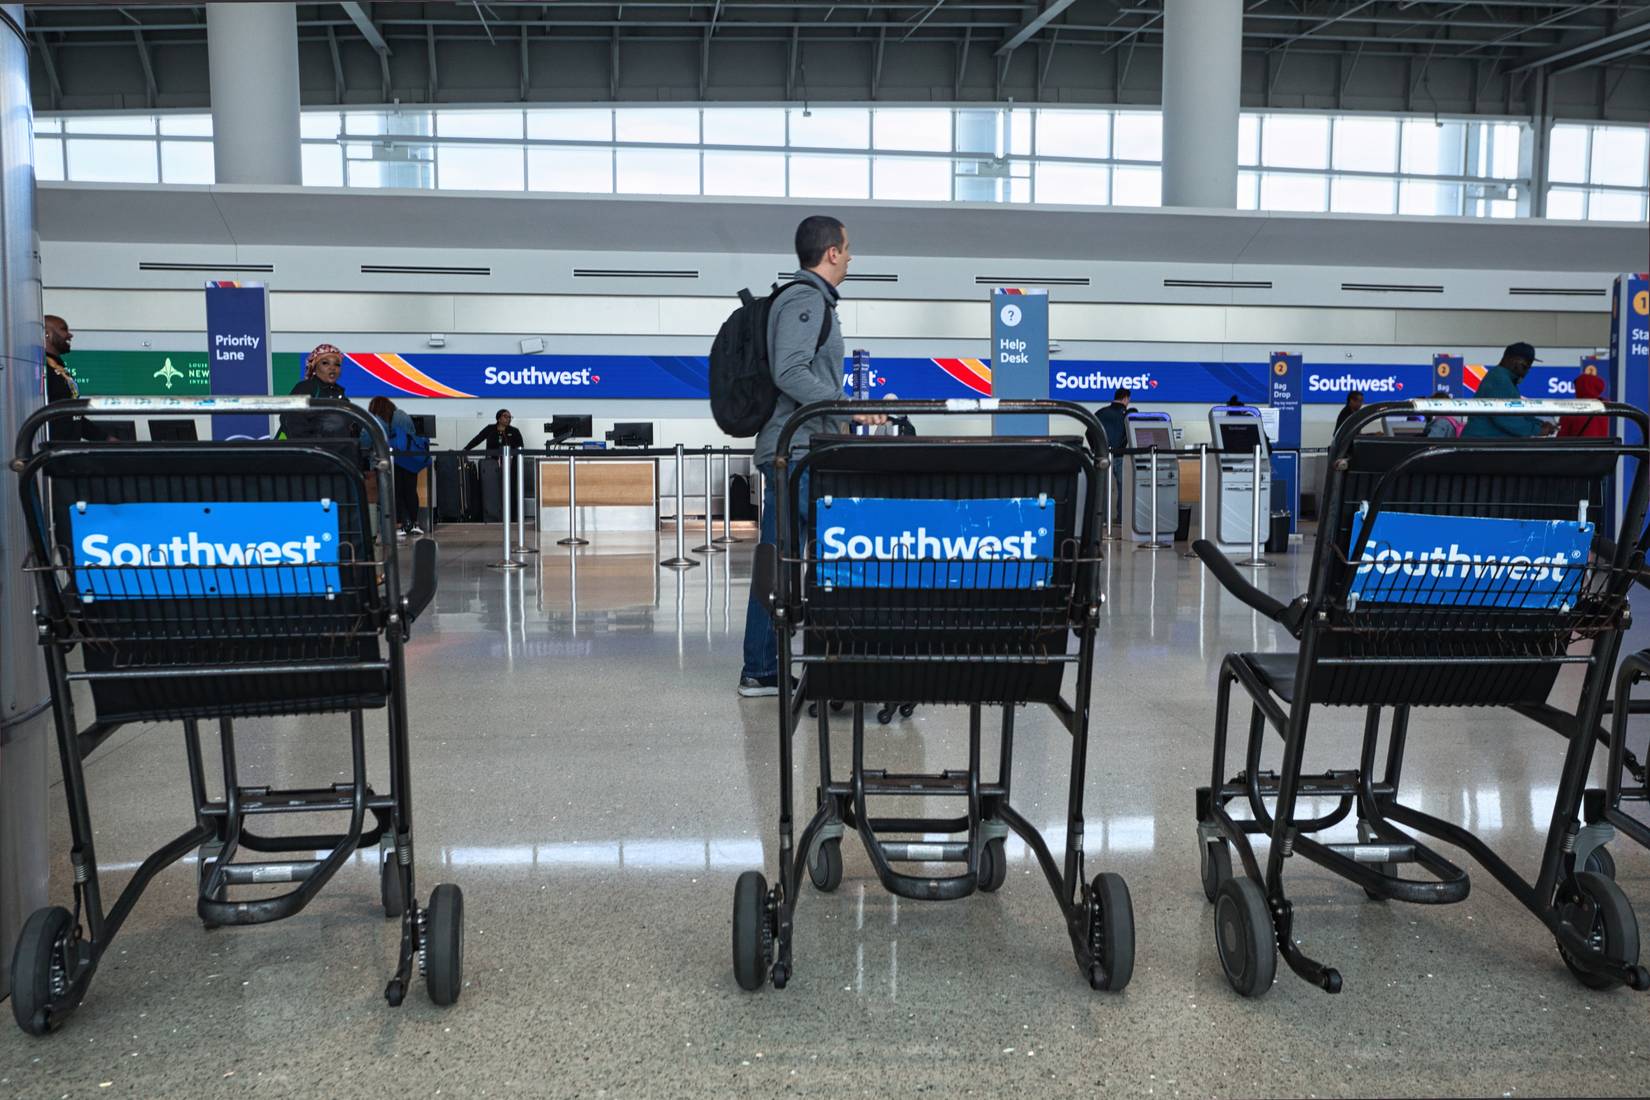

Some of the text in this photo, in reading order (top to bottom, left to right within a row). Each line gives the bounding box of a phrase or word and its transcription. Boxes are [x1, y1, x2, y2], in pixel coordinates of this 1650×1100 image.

[1631, 328, 1649, 340] Sta
[215, 334, 260, 349] Priority
[1000, 338, 1027, 352] Help
[216, 349, 245, 360] Lane
[1631, 344, 1649, 355] He
[1000, 352, 1029, 363] Desk
[188, 369, 210, 378] NEW
[1273, 382, 1287, 391] Bag
[1548, 377, 1576, 394] Sou
[1273, 391, 1291, 399] Drop
